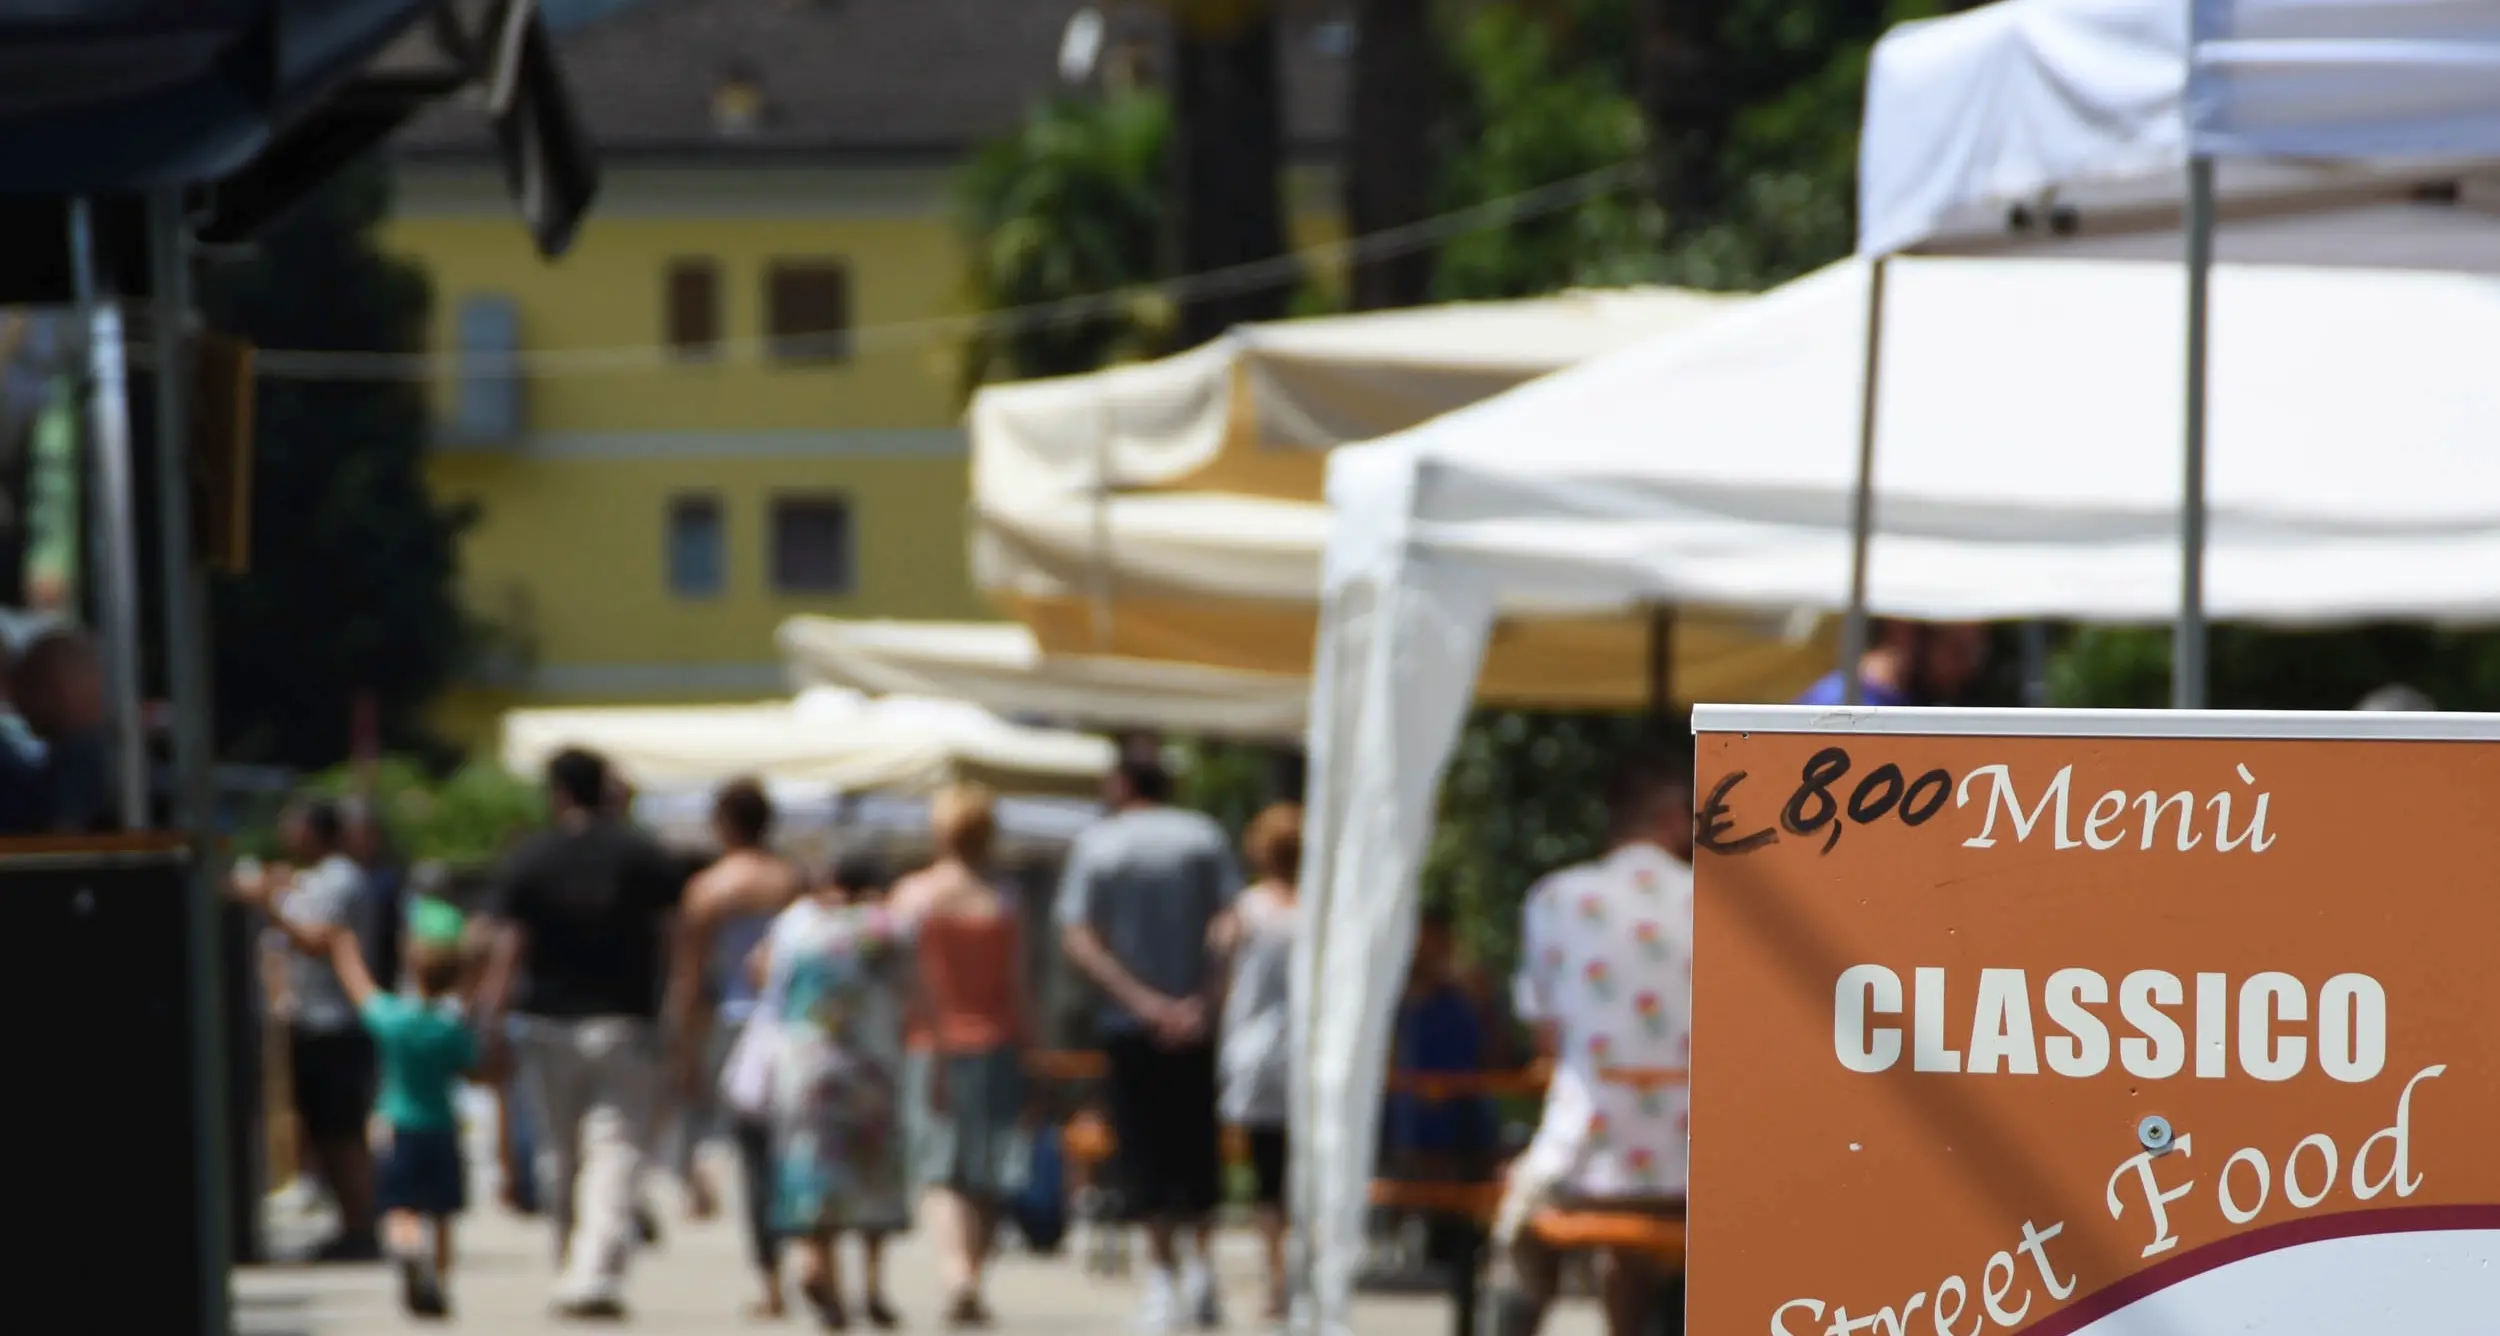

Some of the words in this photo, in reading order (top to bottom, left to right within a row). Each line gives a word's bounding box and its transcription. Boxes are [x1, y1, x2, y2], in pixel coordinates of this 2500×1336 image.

[1956, 762, 2277, 854] Menù
[1833, 963, 2387, 1084] CLASSICO
[2105, 1063, 2447, 1260] Food
